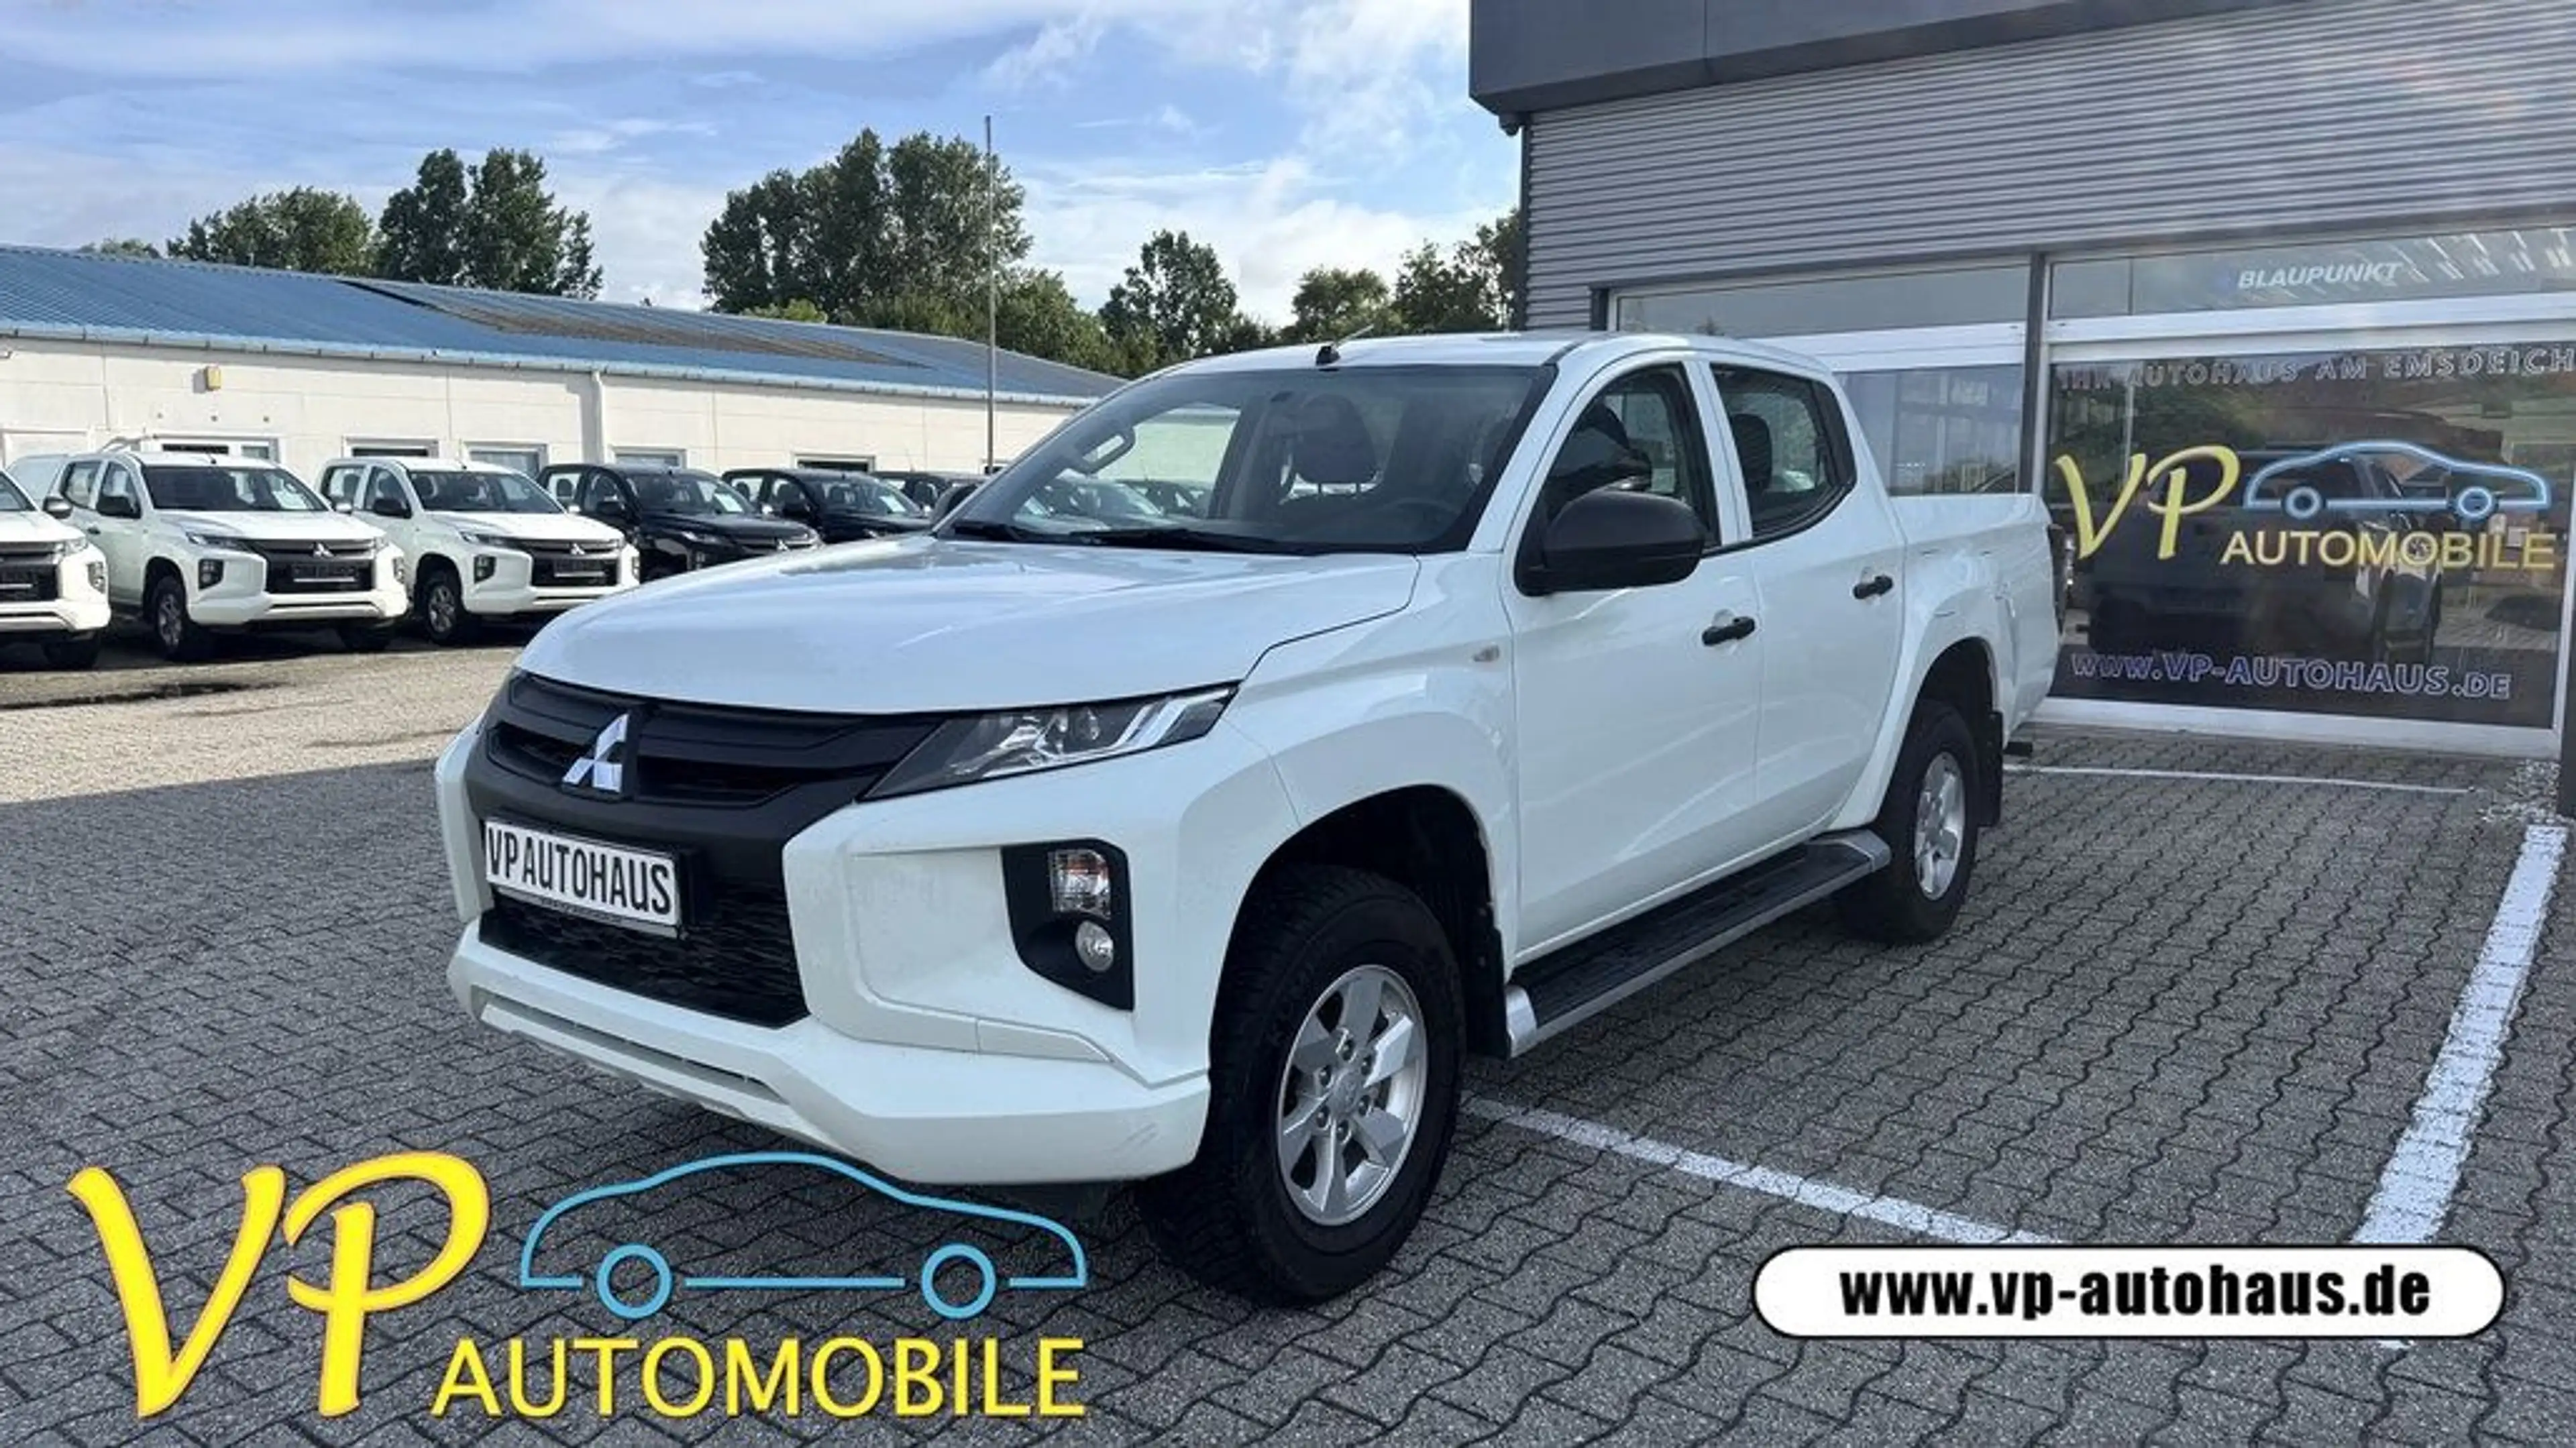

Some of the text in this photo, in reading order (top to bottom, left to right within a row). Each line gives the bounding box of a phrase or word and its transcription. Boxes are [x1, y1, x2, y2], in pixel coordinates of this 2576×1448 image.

[2238, 262, 2403, 289] BLAUPUNKT
[2123, 362, 2299, 388] AUTOHAUS
[2315, 355, 2367, 381] AM
[2383, 347, 2575, 379] EMSDEICH
[2055, 445, 2241, 560] VP
[2220, 530, 2557, 569] AUTOMOBILE
[488, 828, 519, 879] VP
[523, 837, 671, 915] AUTOHAUS
